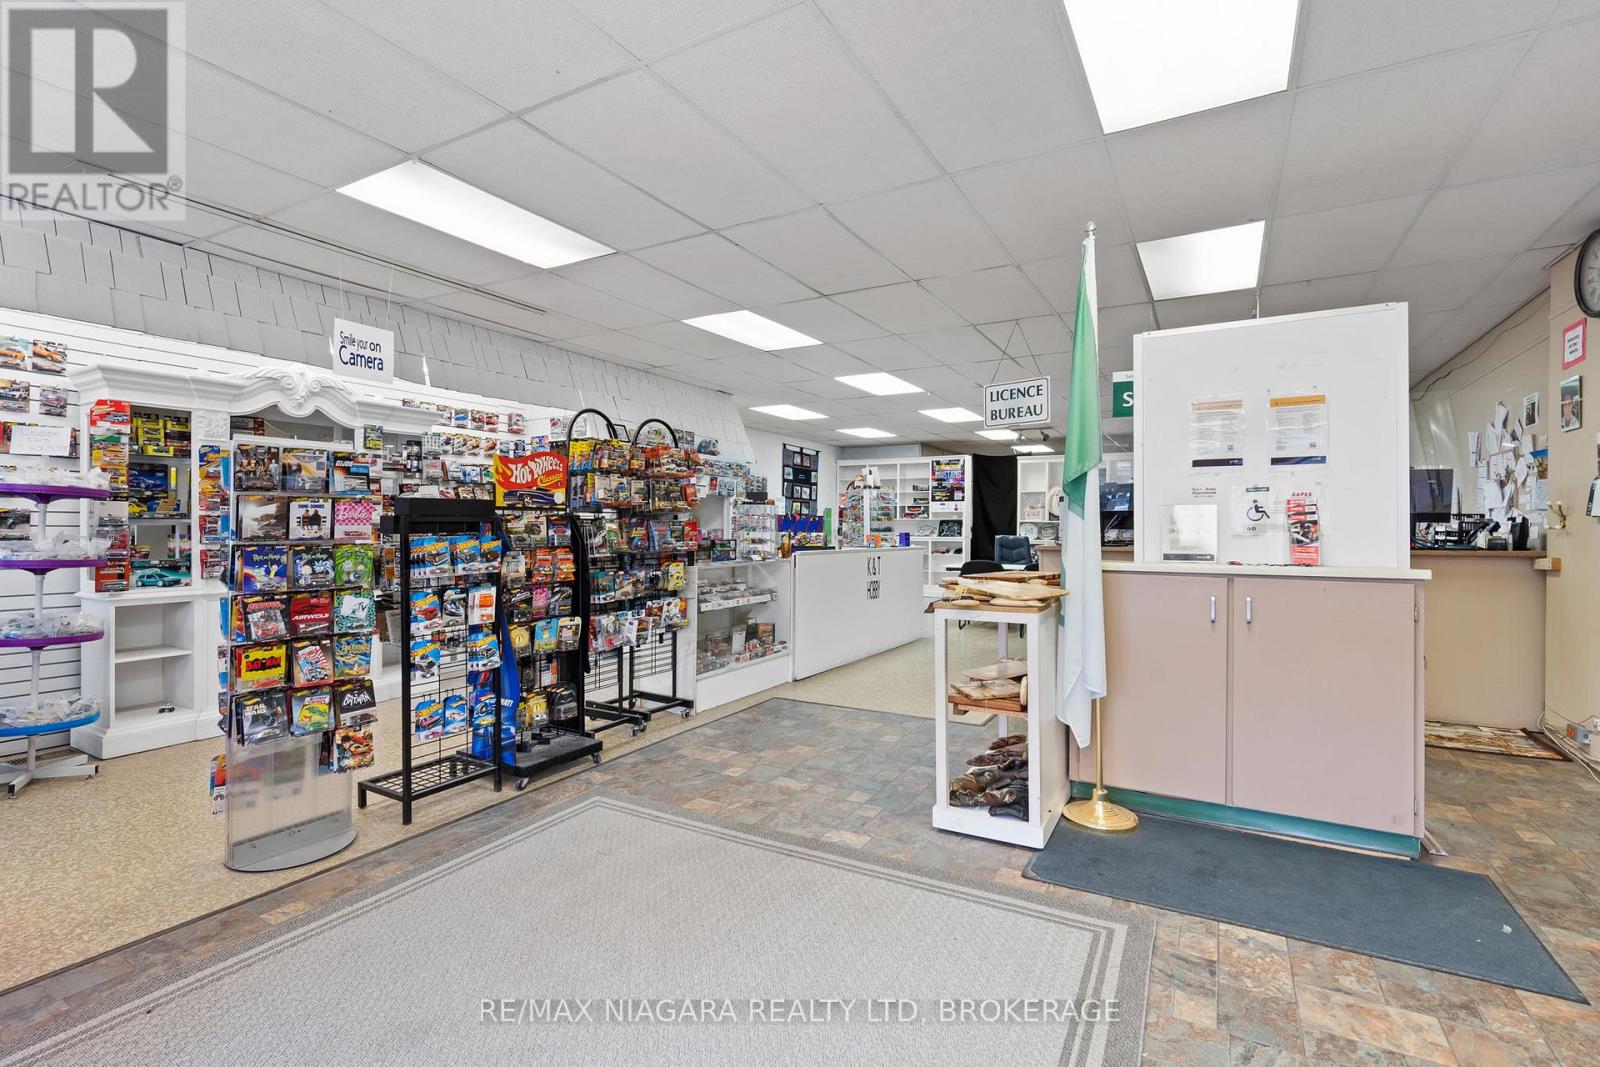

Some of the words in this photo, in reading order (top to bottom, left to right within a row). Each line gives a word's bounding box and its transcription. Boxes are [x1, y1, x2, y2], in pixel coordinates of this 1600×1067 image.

[339, 330, 356, 347] Smile
[368, 341, 382, 353] on
[338, 344, 384, 372] Camera
[990, 384, 1044, 402] LICENCE
[990, 404, 1043, 421] BUREAU
[335, 505, 369, 520] Barbie
[867, 556, 871, 576] K
[877, 556, 881, 575] T
[867, 580, 880, 600] HOBBY
